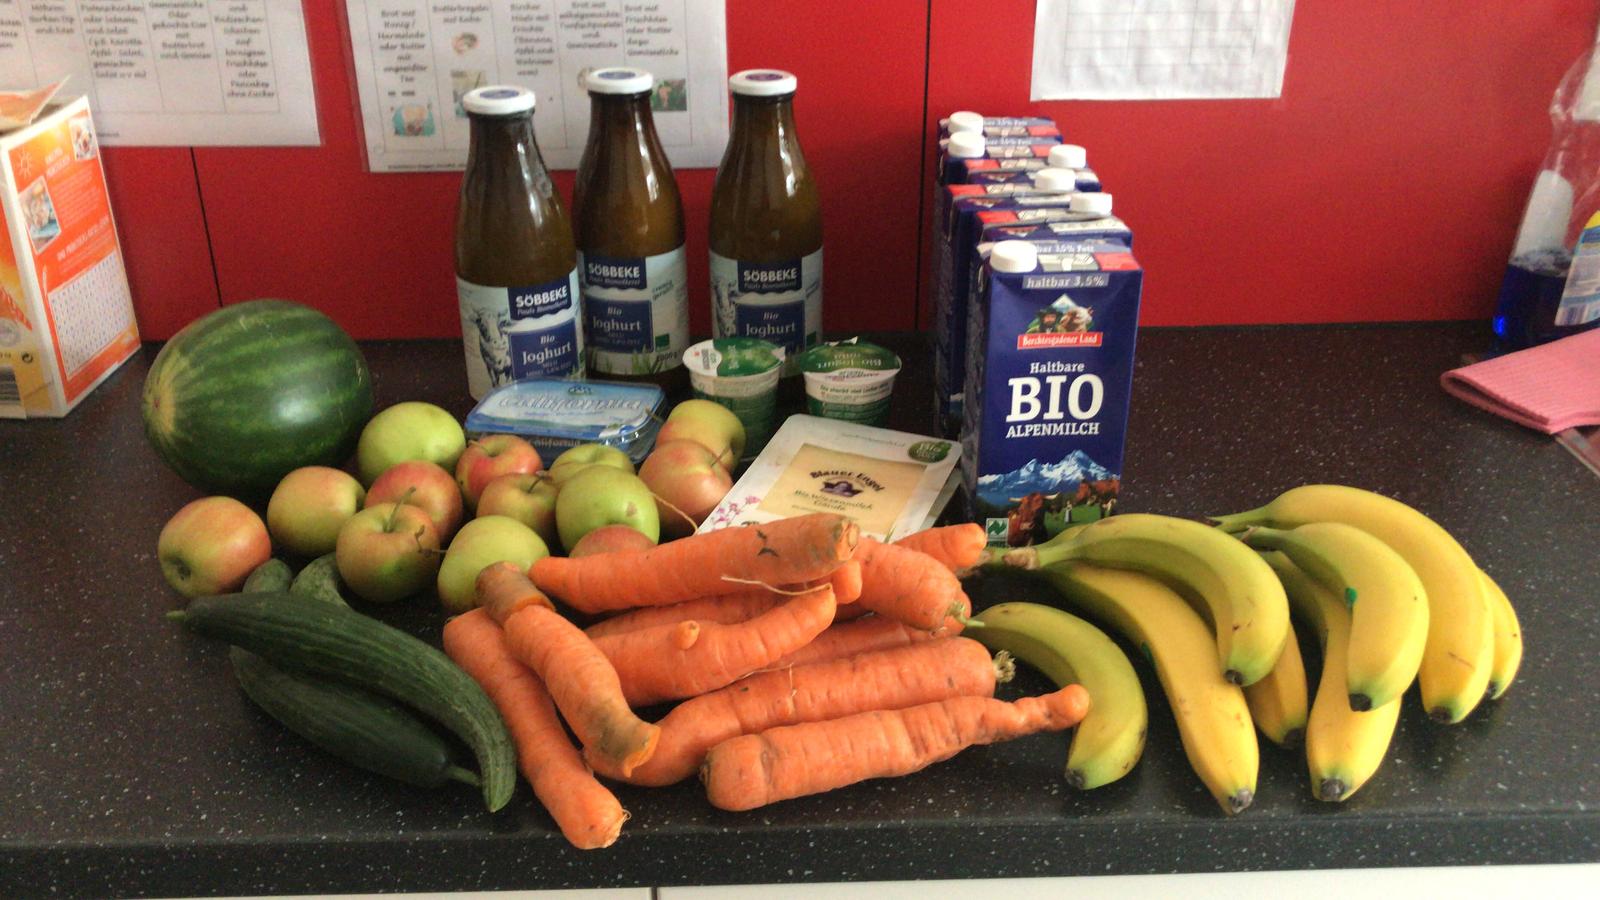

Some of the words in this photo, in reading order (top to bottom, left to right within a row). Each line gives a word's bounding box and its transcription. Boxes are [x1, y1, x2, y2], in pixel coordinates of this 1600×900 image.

[587, 262, 642, 279] SÖBBEKE
[743, 267, 799, 282] SÖBBEKE
[1026, 275, 1071, 289] haltbar
[514, 284, 569, 309] SÖBBEKE
[591, 315, 642, 332] Joghurt
[745, 321, 797, 337] Joghurt
[540, 334, 556, 345] Bio
[521, 341, 572, 366] Joghurt
[1029, 360, 1086, 374] Haltbare
[1005, 373, 1105, 423] BIO
[1004, 421, 1101, 439] ALPENMILCH
[809, 469, 854, 479] Blauer
[855, 471, 886, 492] Engel
